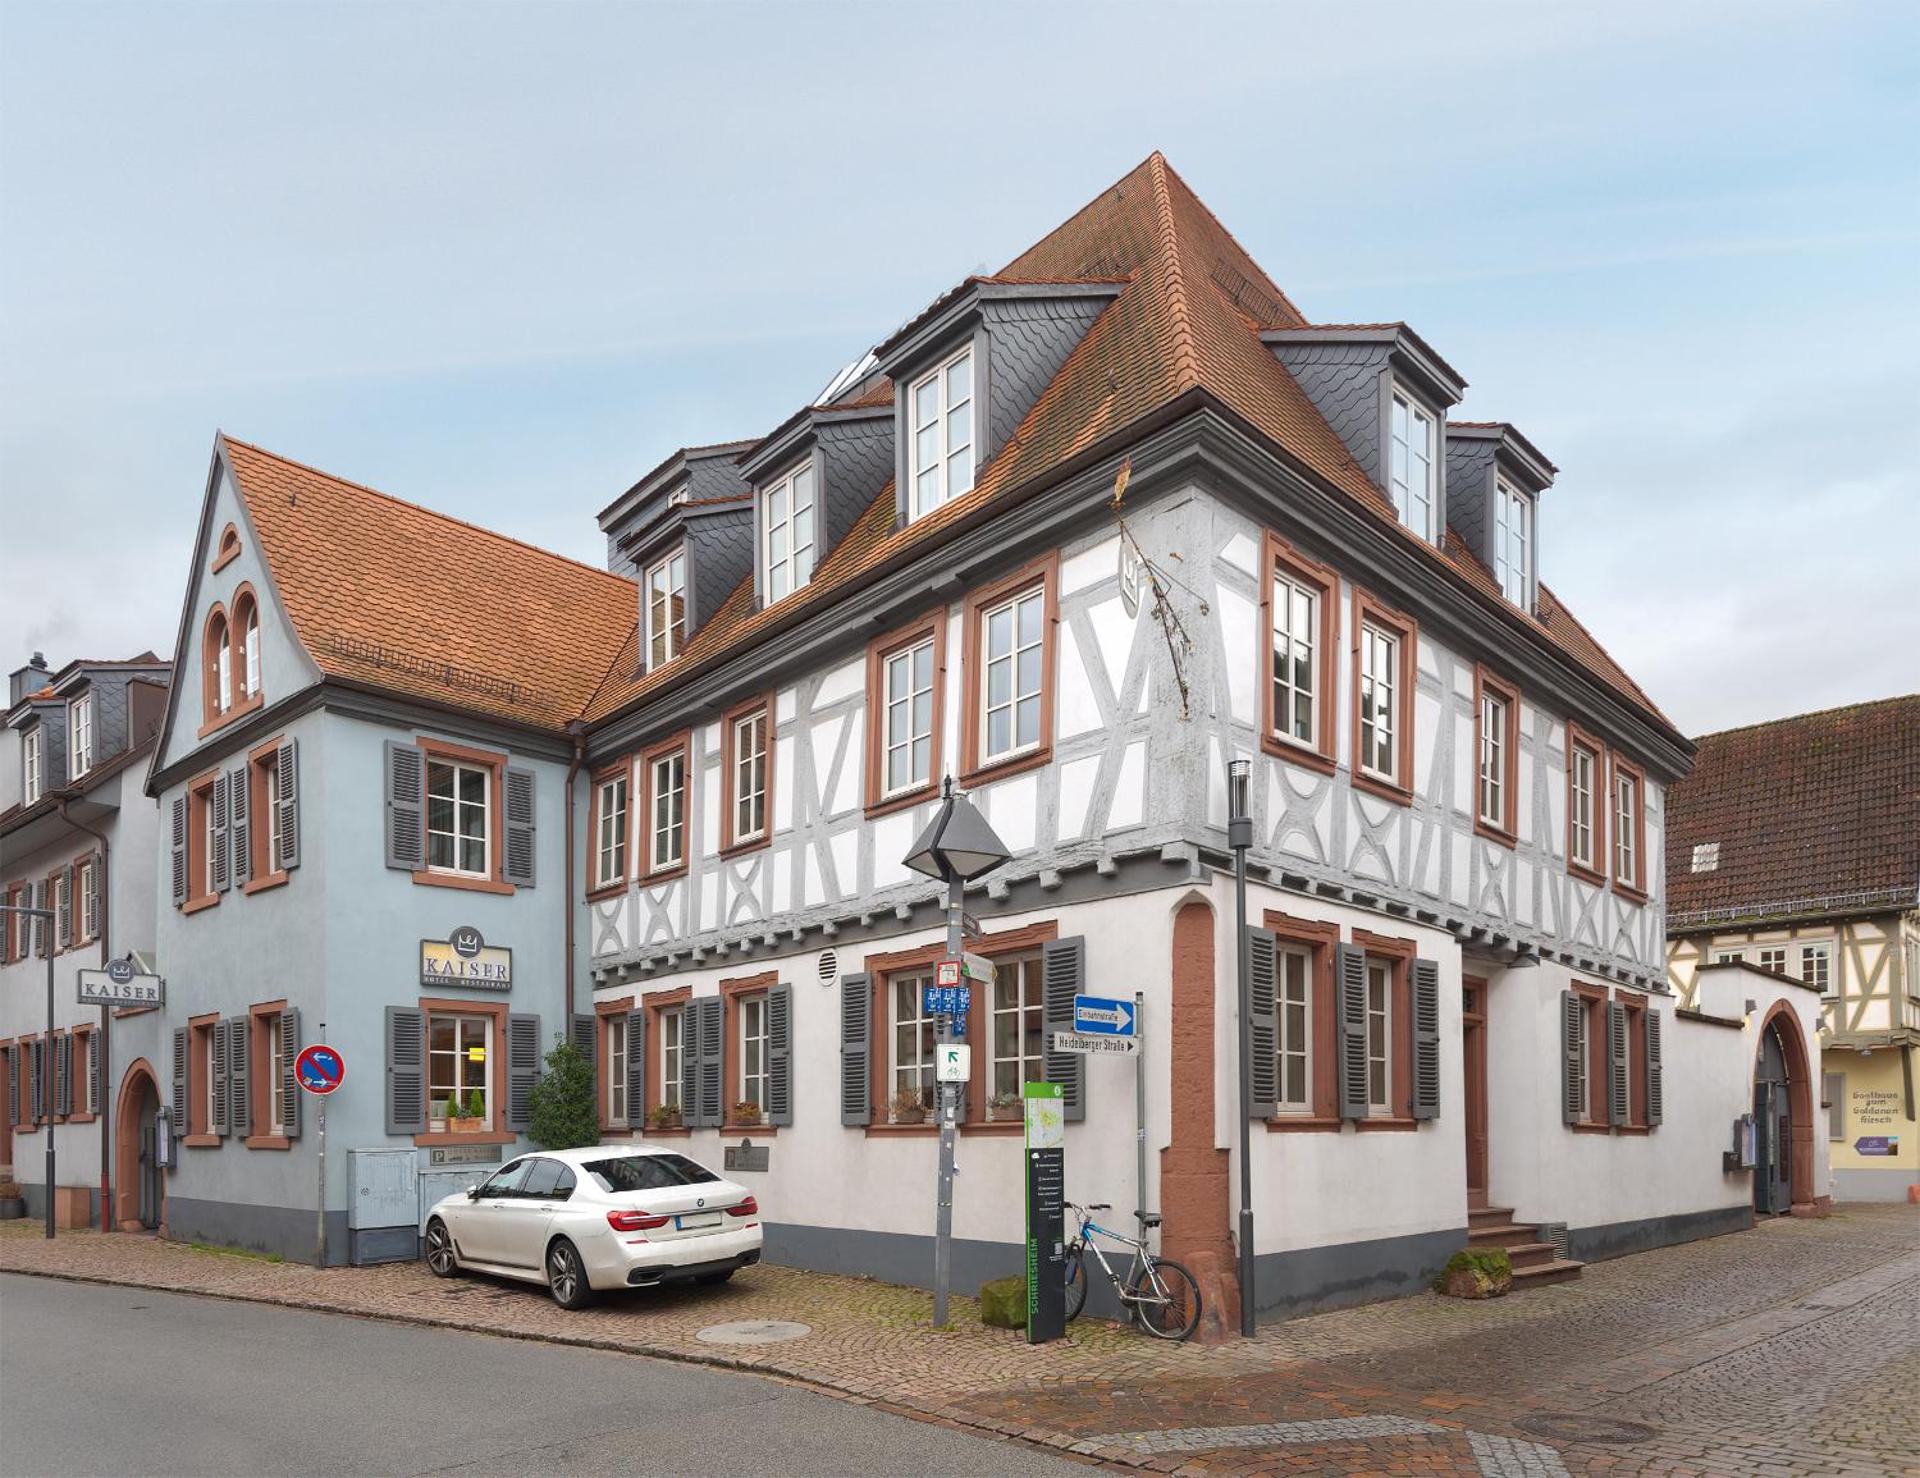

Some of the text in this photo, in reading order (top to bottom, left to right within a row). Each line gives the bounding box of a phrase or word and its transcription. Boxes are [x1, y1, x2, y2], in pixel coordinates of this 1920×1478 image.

[425, 958, 506, 979] KAISER
[85, 983, 156, 999] KAISER
[1079, 1009, 1118, 1021] Ebahnstraße
[1059, 1036, 1125, 1053] Heidelberger Straße
[1030, 1238, 1039, 1315] SCHRIESHEIM
